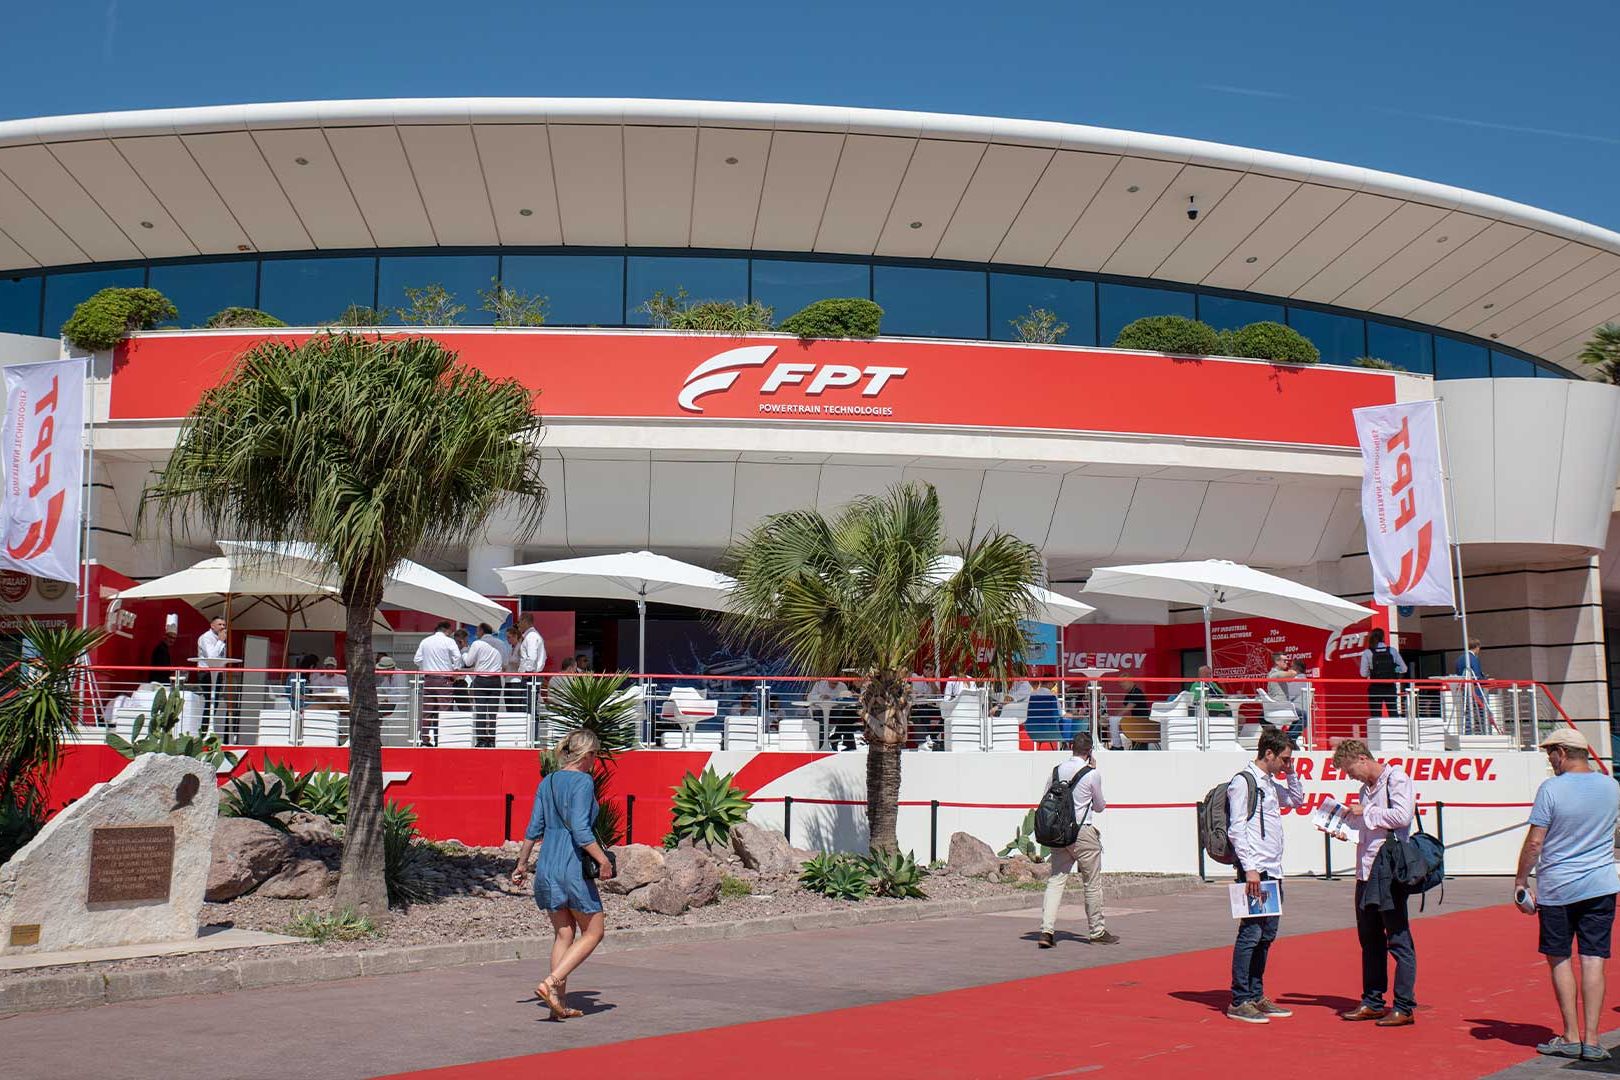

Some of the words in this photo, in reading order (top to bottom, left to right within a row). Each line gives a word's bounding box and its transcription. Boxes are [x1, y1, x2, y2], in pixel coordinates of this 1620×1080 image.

[759, 363, 908, 396] FPT
[759, 403, 821, 415] POWERTRAIN
[823, 405, 893, 417] TECHNOLOGIES
[1338, 631, 1369, 650] FPT
